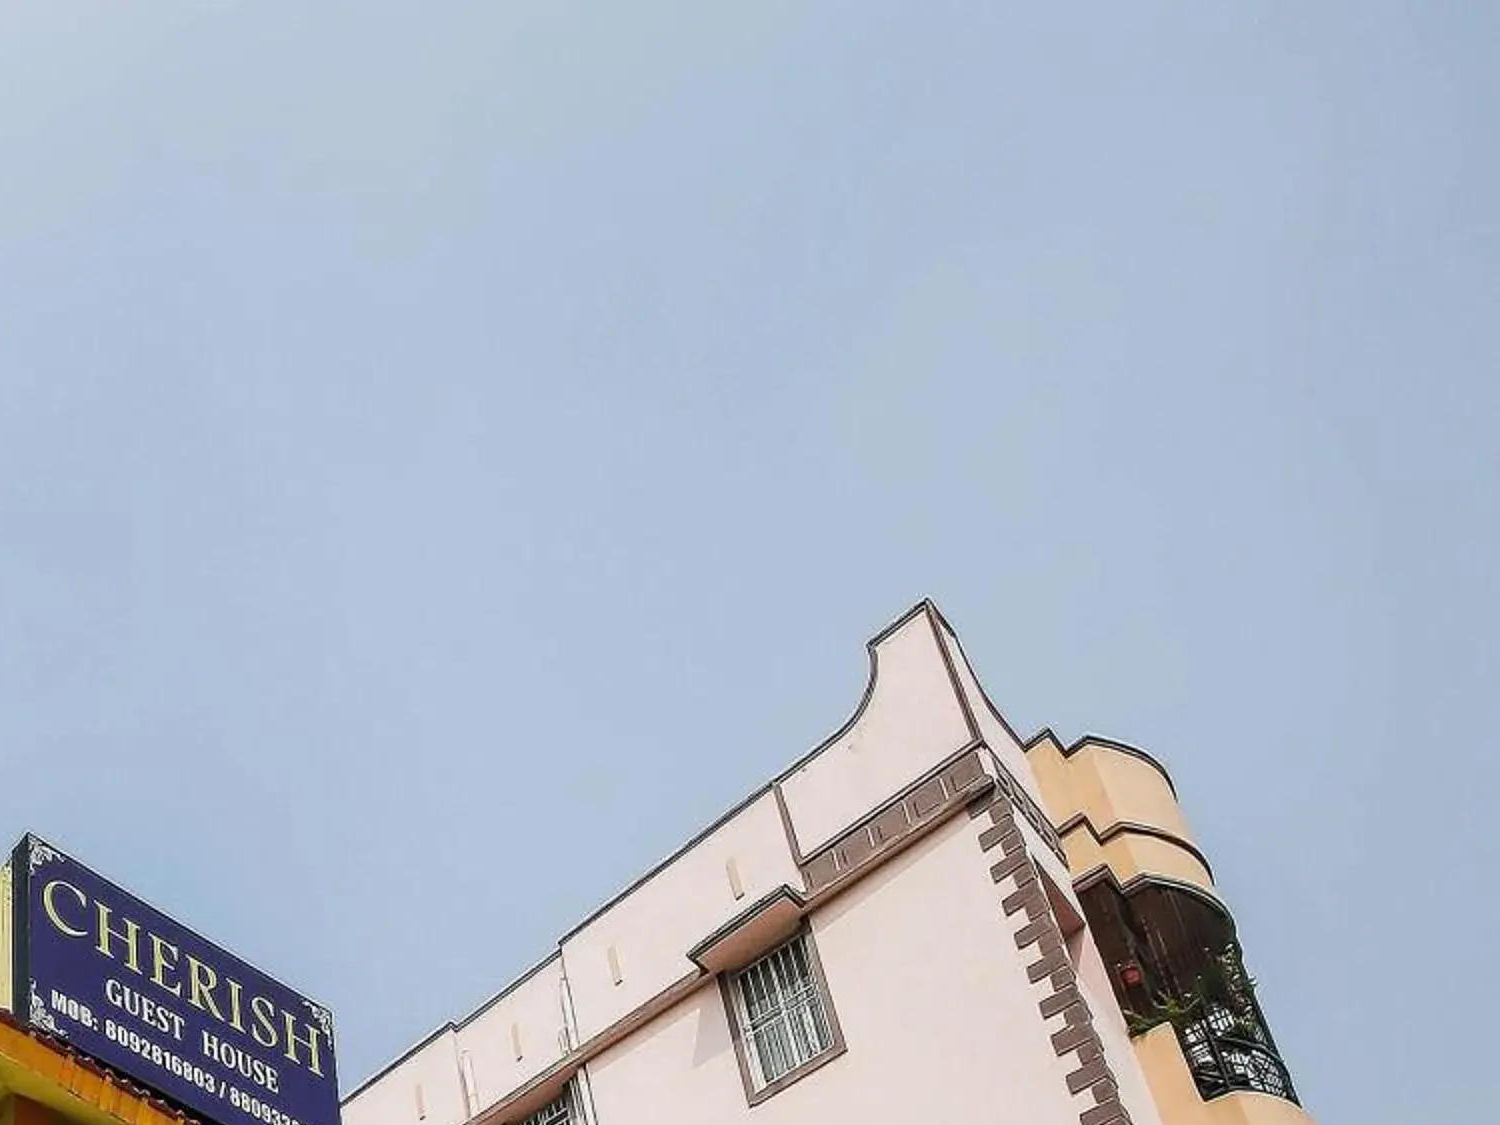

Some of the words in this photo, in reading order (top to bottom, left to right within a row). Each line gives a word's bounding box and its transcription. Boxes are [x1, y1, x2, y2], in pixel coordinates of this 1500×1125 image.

[43, 880, 325, 1078] CHERISH
[51, 989, 99, 1031] MOB:
[105, 978, 185, 1041] GUEST
[201, 1029, 279, 1094] HOUSE
